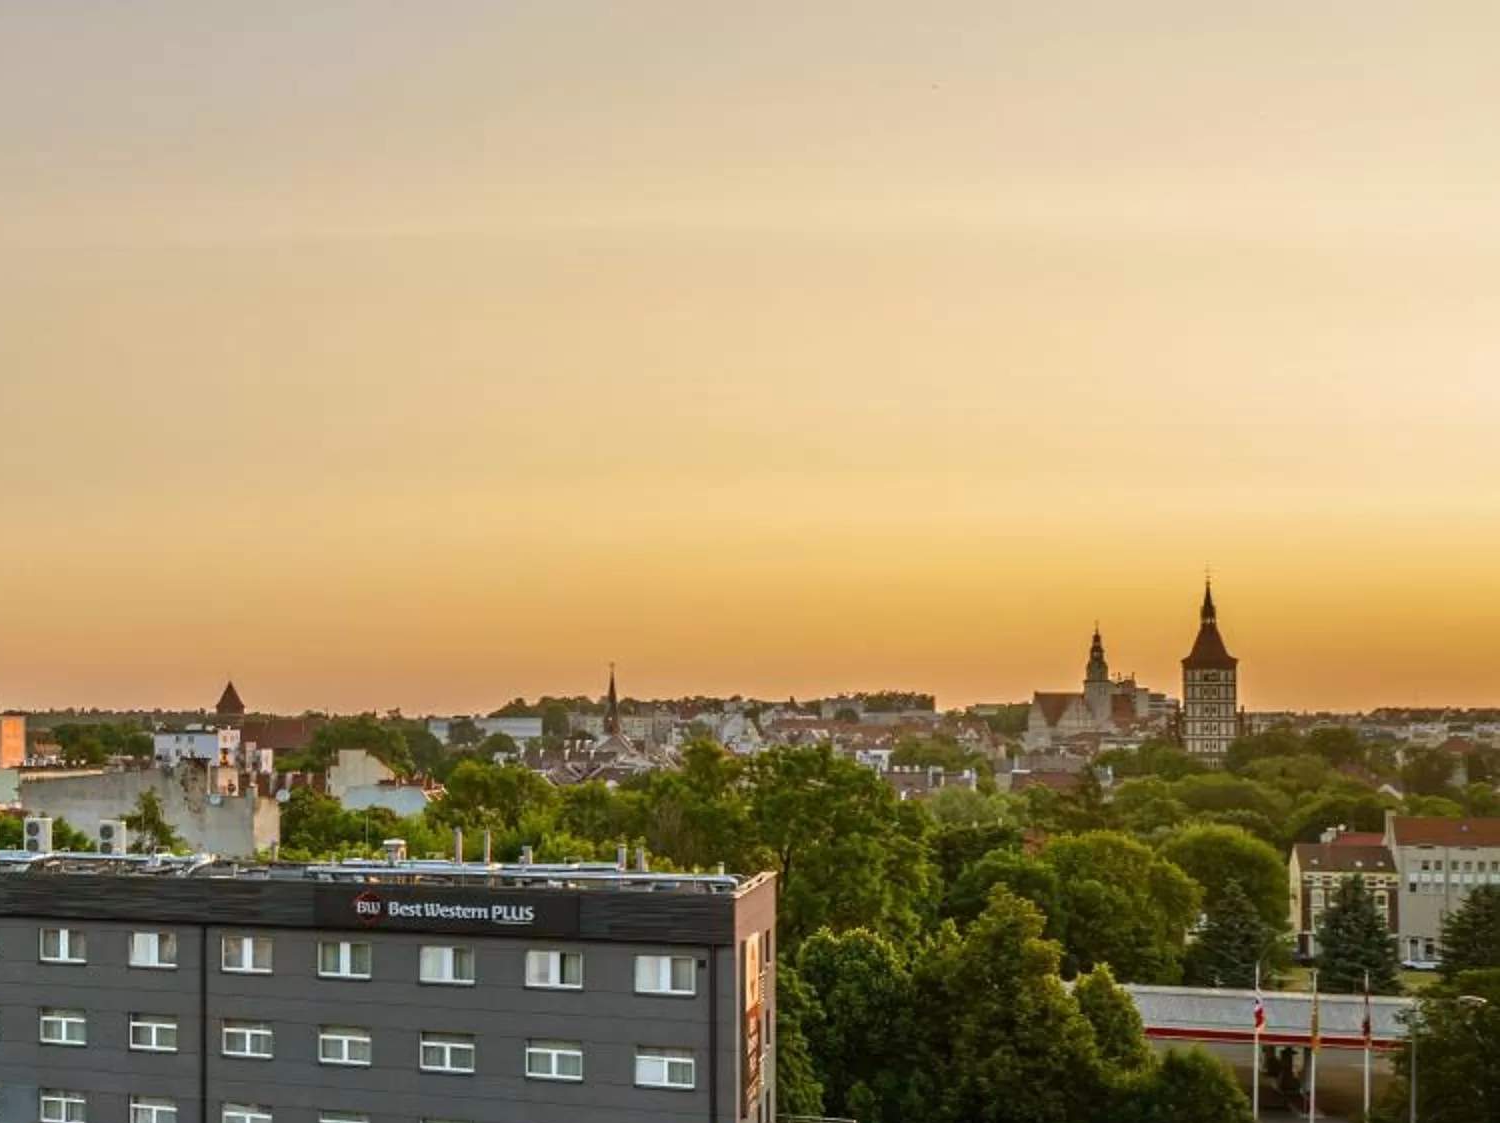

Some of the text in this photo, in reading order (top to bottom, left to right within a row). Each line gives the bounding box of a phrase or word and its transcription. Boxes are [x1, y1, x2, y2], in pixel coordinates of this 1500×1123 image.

[356, 901, 381, 914] BW
[388, 901, 535, 921] Best Western PLUS
